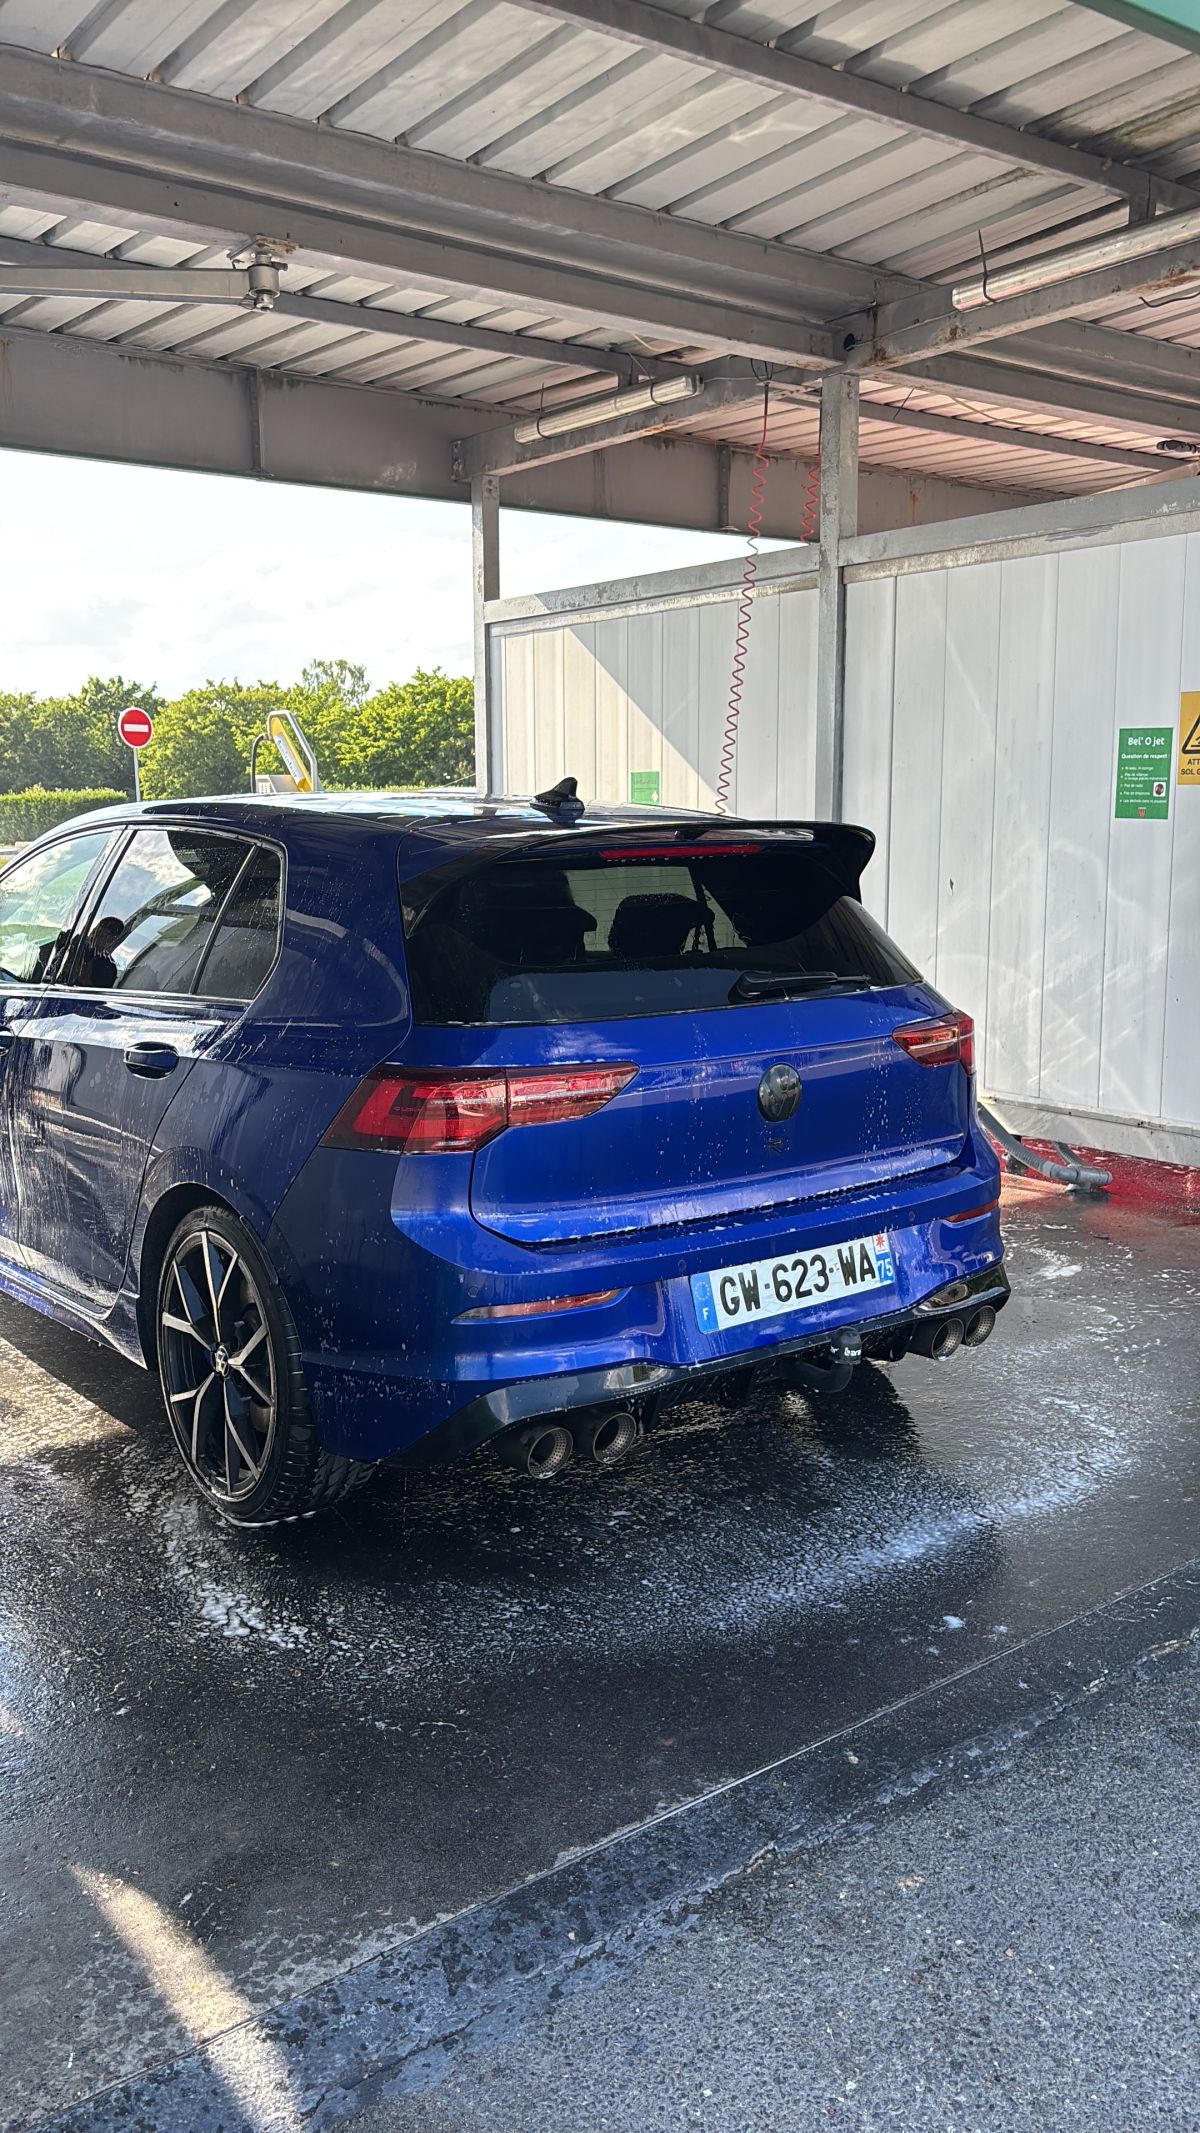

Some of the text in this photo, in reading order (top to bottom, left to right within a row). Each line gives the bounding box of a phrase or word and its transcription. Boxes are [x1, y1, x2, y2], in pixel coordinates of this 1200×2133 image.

[1128, 737, 1165, 747] Bel' O jet
[1180, 768, 1195, 776] SOL
[878, 1258, 893, 1279] 75
[702, 1308, 709, 1321] F
